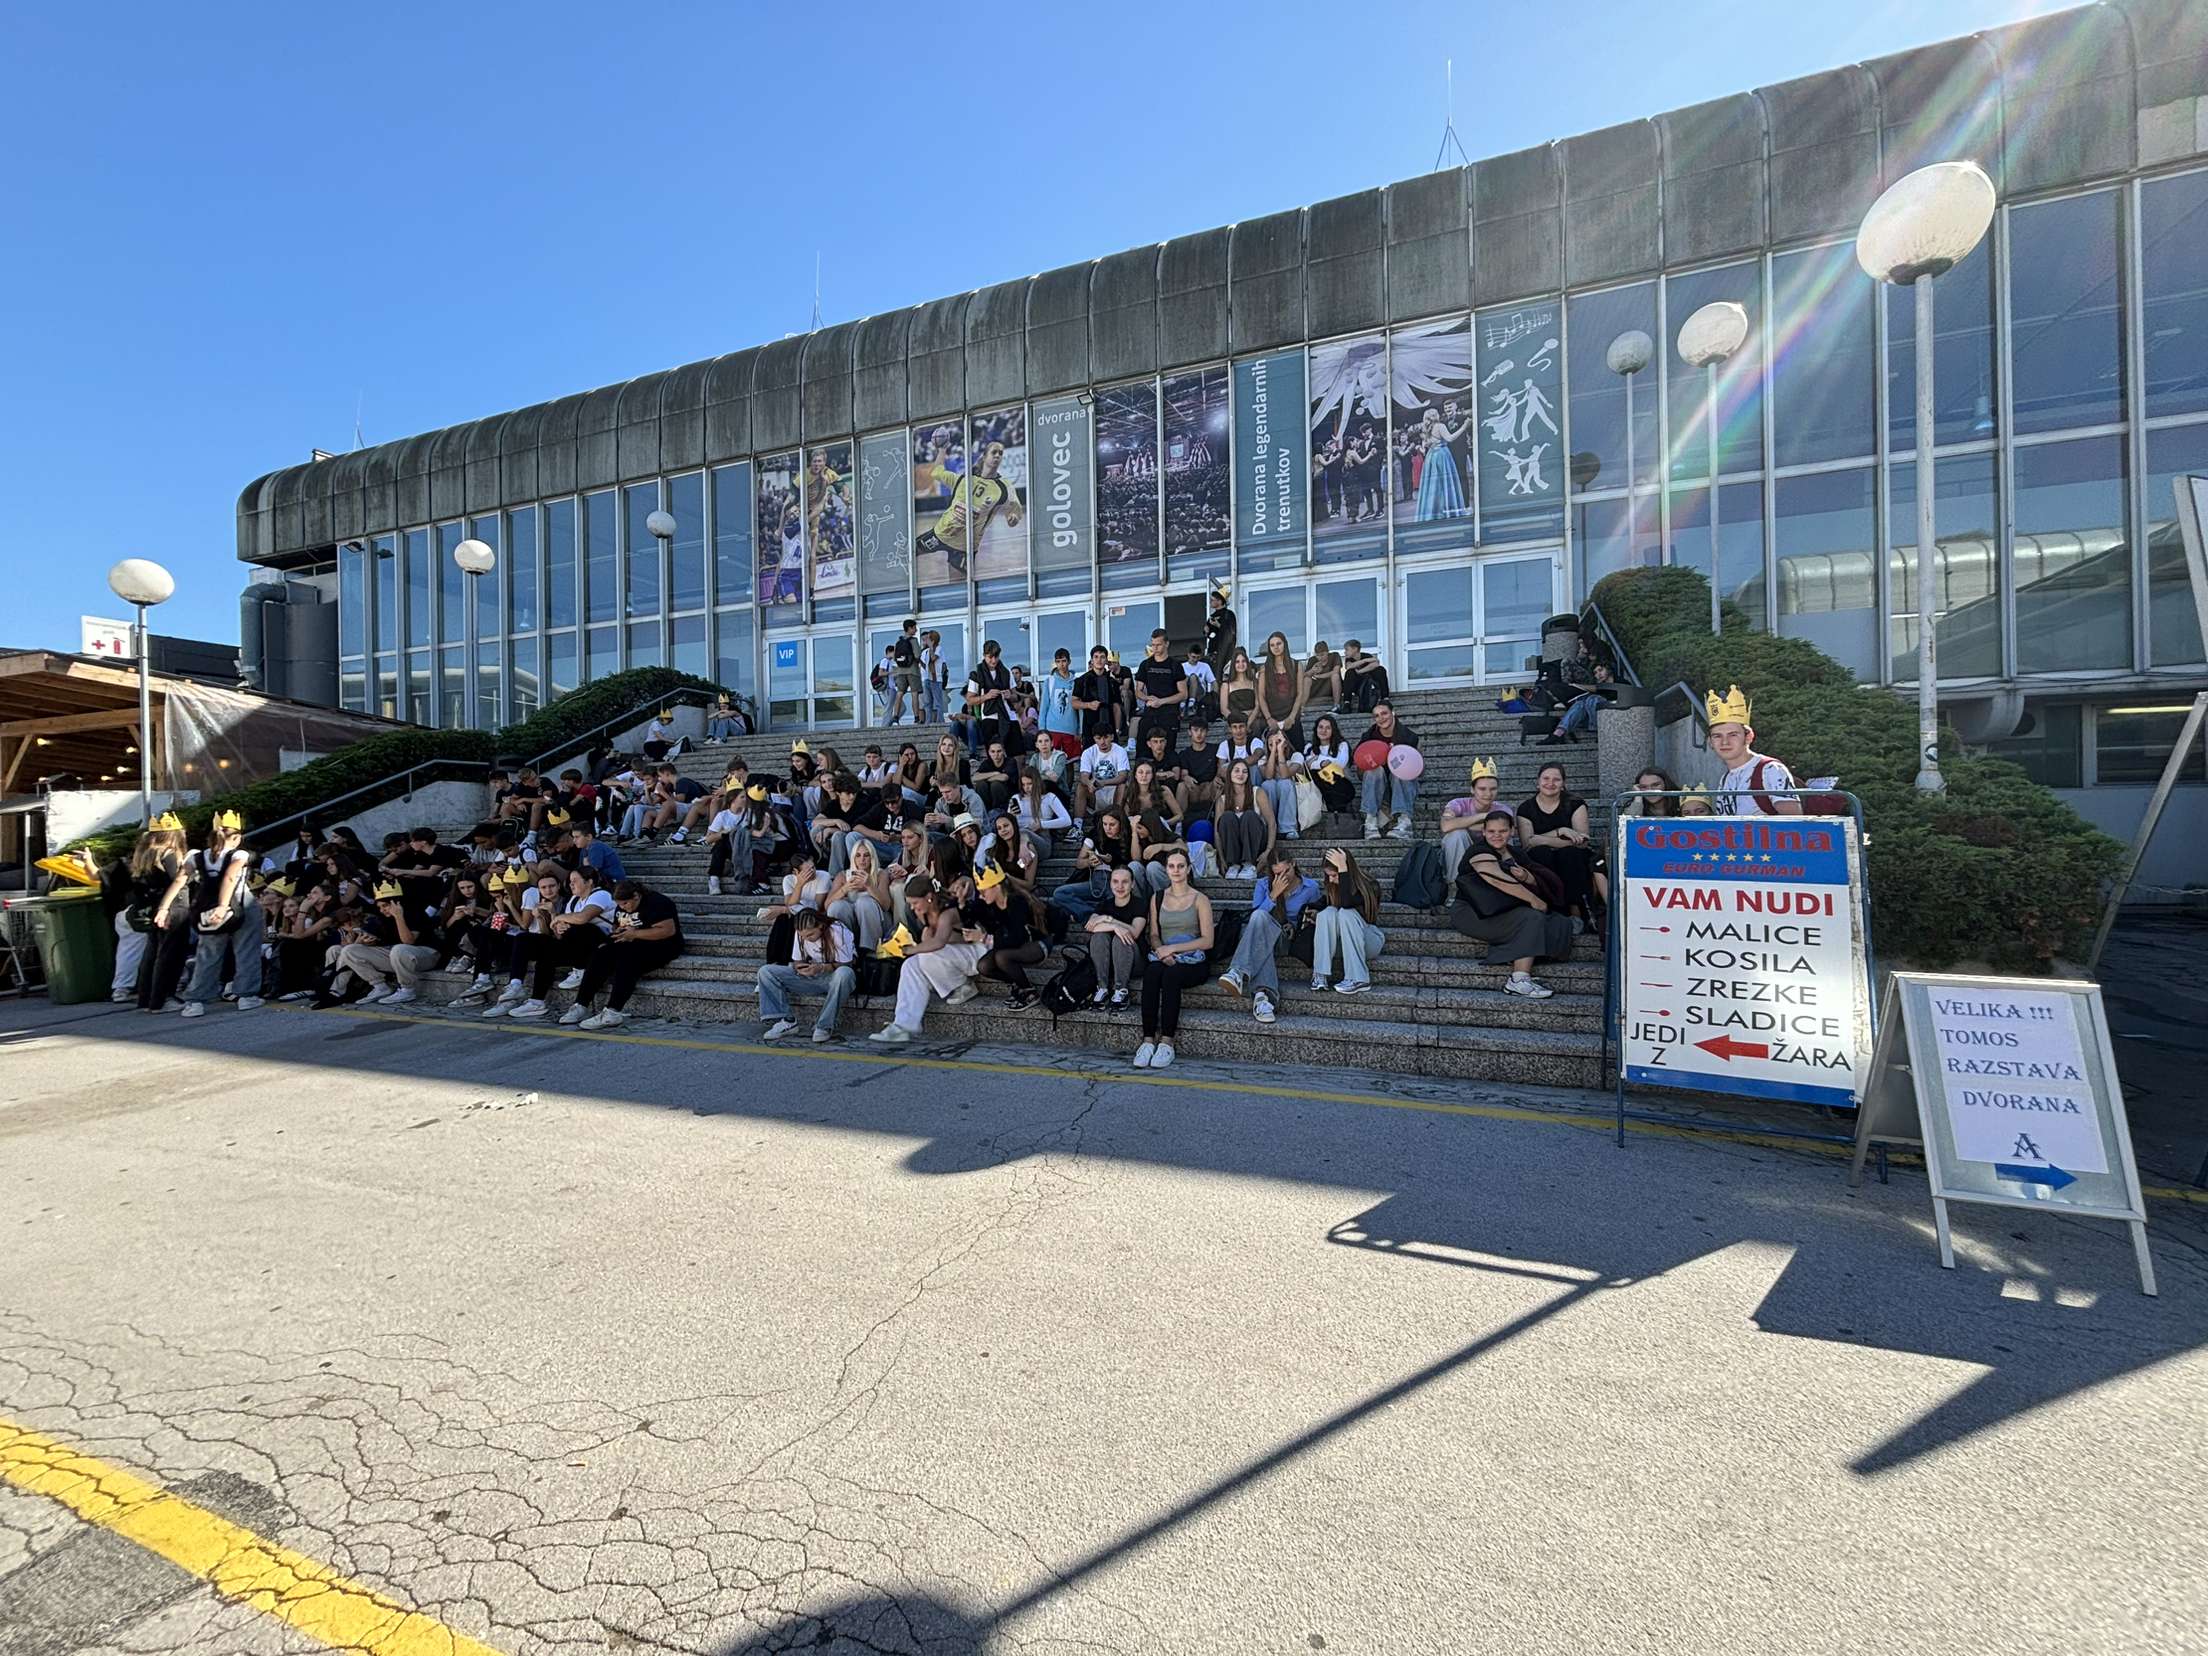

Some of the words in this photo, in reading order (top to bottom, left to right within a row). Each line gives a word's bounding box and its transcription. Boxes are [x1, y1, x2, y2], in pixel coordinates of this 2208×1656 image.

[1037, 408, 1087, 426] dvorana
[1251, 359, 1271, 461] legendarnih
[1046, 431, 1078, 548] golovec
[1252, 463, 1267, 536] Dvorana
[1275, 447, 1291, 532] trenutkov
[778, 649, 795, 659] VIP
[1635, 823, 1833, 852] Gostilna
[1663, 863, 1714, 875] EURO
[1720, 864, 1807, 877] GURMAN
[1642, 886, 1722, 911] VAM
[1736, 890, 1834, 916] NUDI
[1685, 921, 1822, 946] MALICE
[1685, 948, 1817, 975] KOSILA
[1686, 977, 1817, 1006] ZREZKE
[1685, 1006, 1840, 1037] SLADICE
[1935, 999, 2024, 1020] VELIKA
[2030, 1006, 2054, 1020] !!!
[1630, 1022, 1686, 1045] JEDI
[1940, 1028, 2019, 1047] TOMOS
[1650, 1047, 1667, 1066] Z
[1770, 1038, 1852, 1071] ŽARA
[1947, 1058, 2083, 1081] RAZSTAVA
[1962, 1090, 2082, 1114] DVORANA
[2011, 1132, 2046, 1161] A
